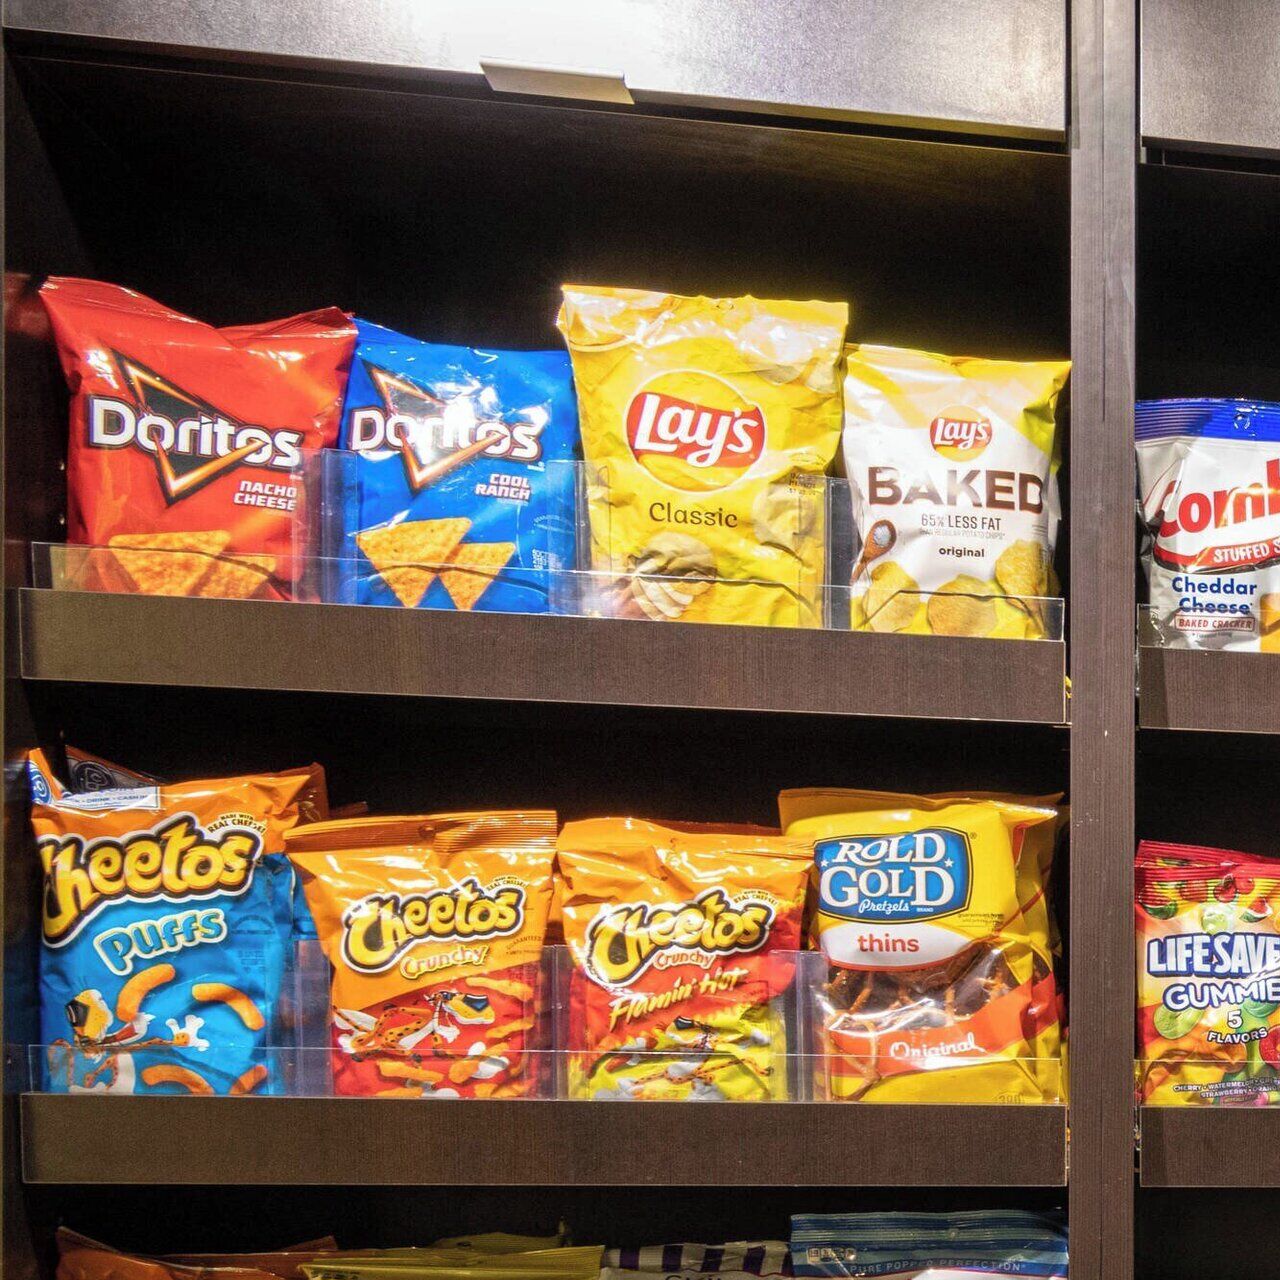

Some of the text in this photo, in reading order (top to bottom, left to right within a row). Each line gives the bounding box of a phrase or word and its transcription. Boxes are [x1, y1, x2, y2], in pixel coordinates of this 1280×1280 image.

[89, 397, 302, 467] Doritos
[634, 393, 761, 467] Lay's
[934, 418, 988, 449] Lay's
[239, 480, 297, 496] NACHO
[489, 473, 530, 488] COOL
[475, 484, 530, 499] RANCH
[868, 466, 1043, 514] BAKED
[234, 492, 296, 510] CHEESE
[649, 502, 738, 528] Classic
[922, 514, 1001, 530] 65% LESS FAT
[939, 547, 984, 557] original
[1214, 542, 1270, 563] STUFFED
[1172, 577, 1256, 595] Cheddar
[1179, 598, 1251, 614] Cheese
[1179, 619, 1210, 629] BAKED
[832, 833, 945, 864] ROLD
[820, 866, 956, 907] GOLD
[859, 898, 910, 914] Pretzels
[349, 887, 523, 971] Cheetos
[591, 892, 768, 981] Cheetos
[858, 933, 919, 953] thins
[656, 952, 713, 967] Crunchy
[1227, 1009, 1242, 1028] 5
[1208, 1028, 1268, 1043] FLAVORS
